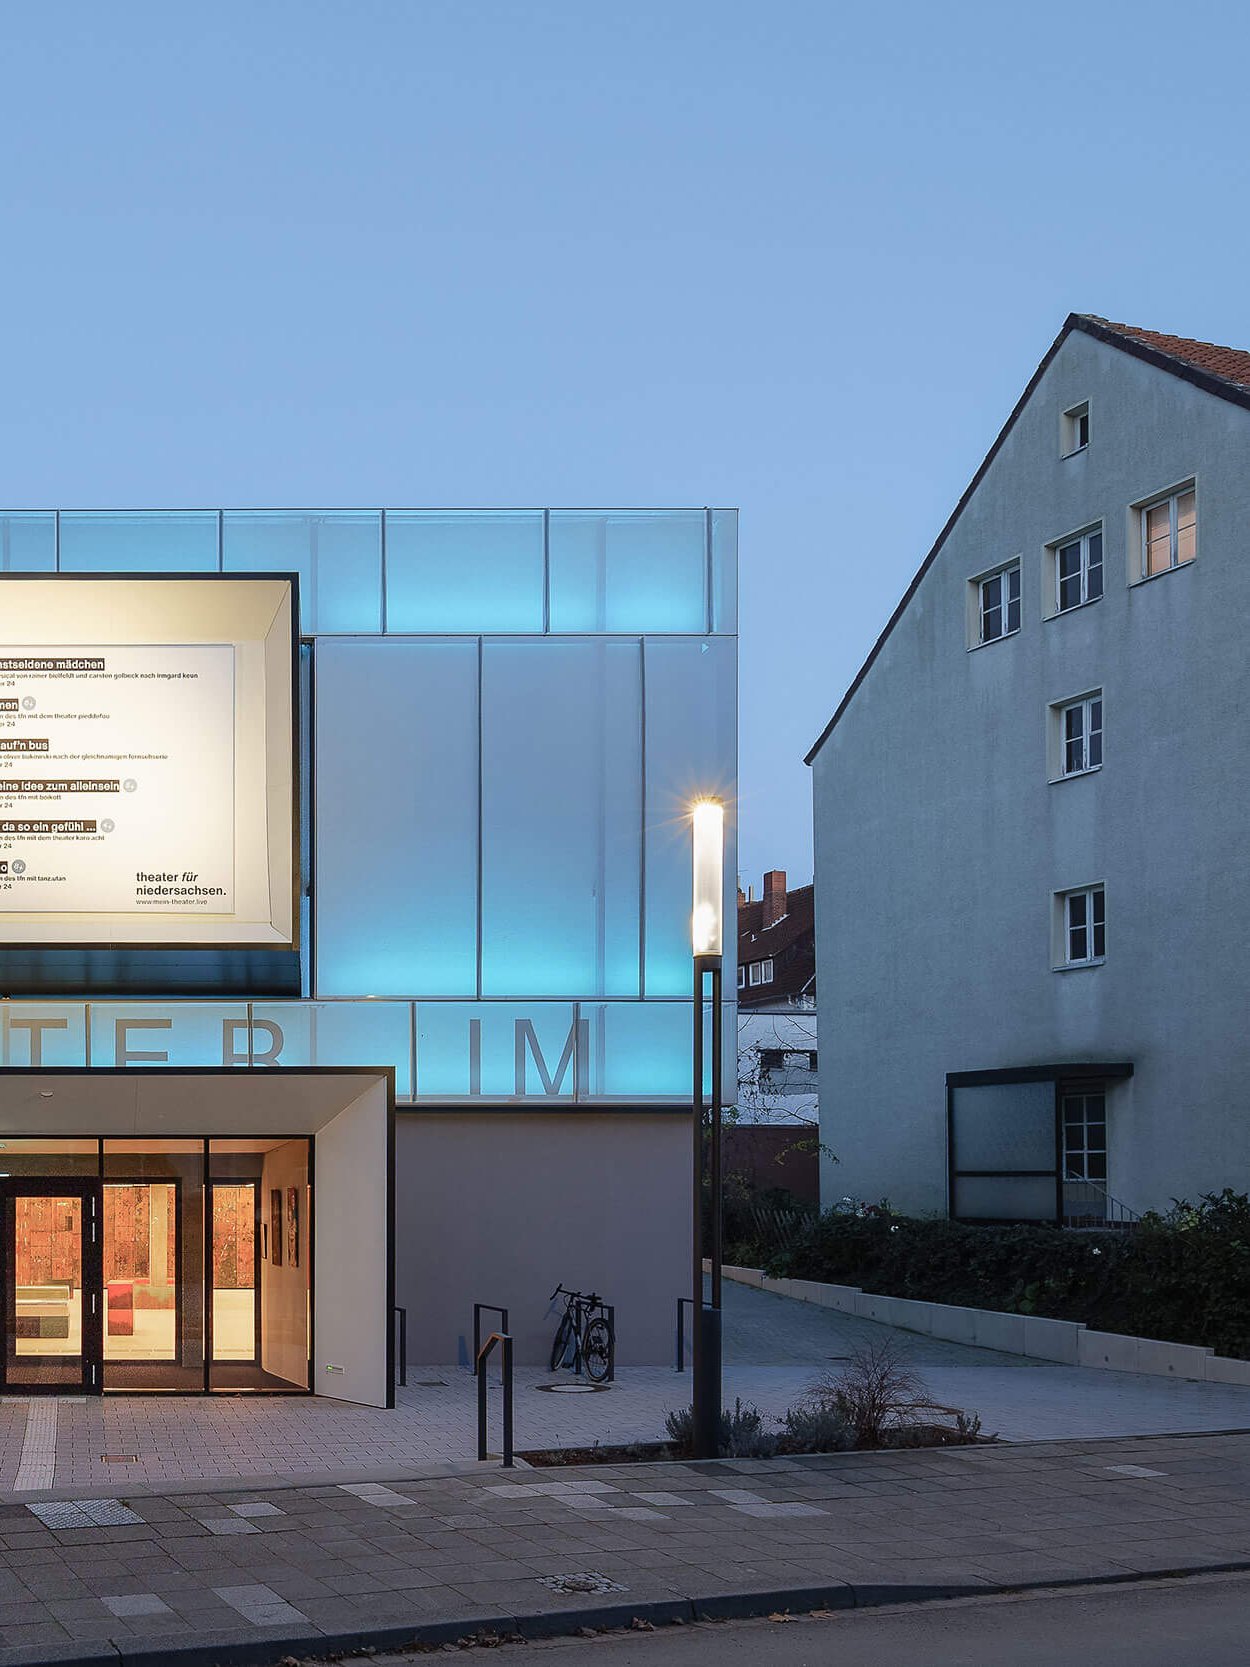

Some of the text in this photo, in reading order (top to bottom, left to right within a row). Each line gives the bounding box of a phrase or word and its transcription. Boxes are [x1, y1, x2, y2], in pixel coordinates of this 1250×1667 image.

[56, 659, 104, 669] mädchen
[29, 741, 48, 750] bus
[21, 781, 44, 791] idee
[46, 781, 68, 791] zum
[70, 781, 119, 791] alleinsein
[2, 822, 15, 831] da
[18, 823, 31, 831] so
[33, 822, 49, 831] ein
[51, 822, 84, 833] gefühl
[136, 872, 198, 882] theater für
[136, 885, 227, 895] niedersachsen.
[469, 1018, 590, 1096] IM
